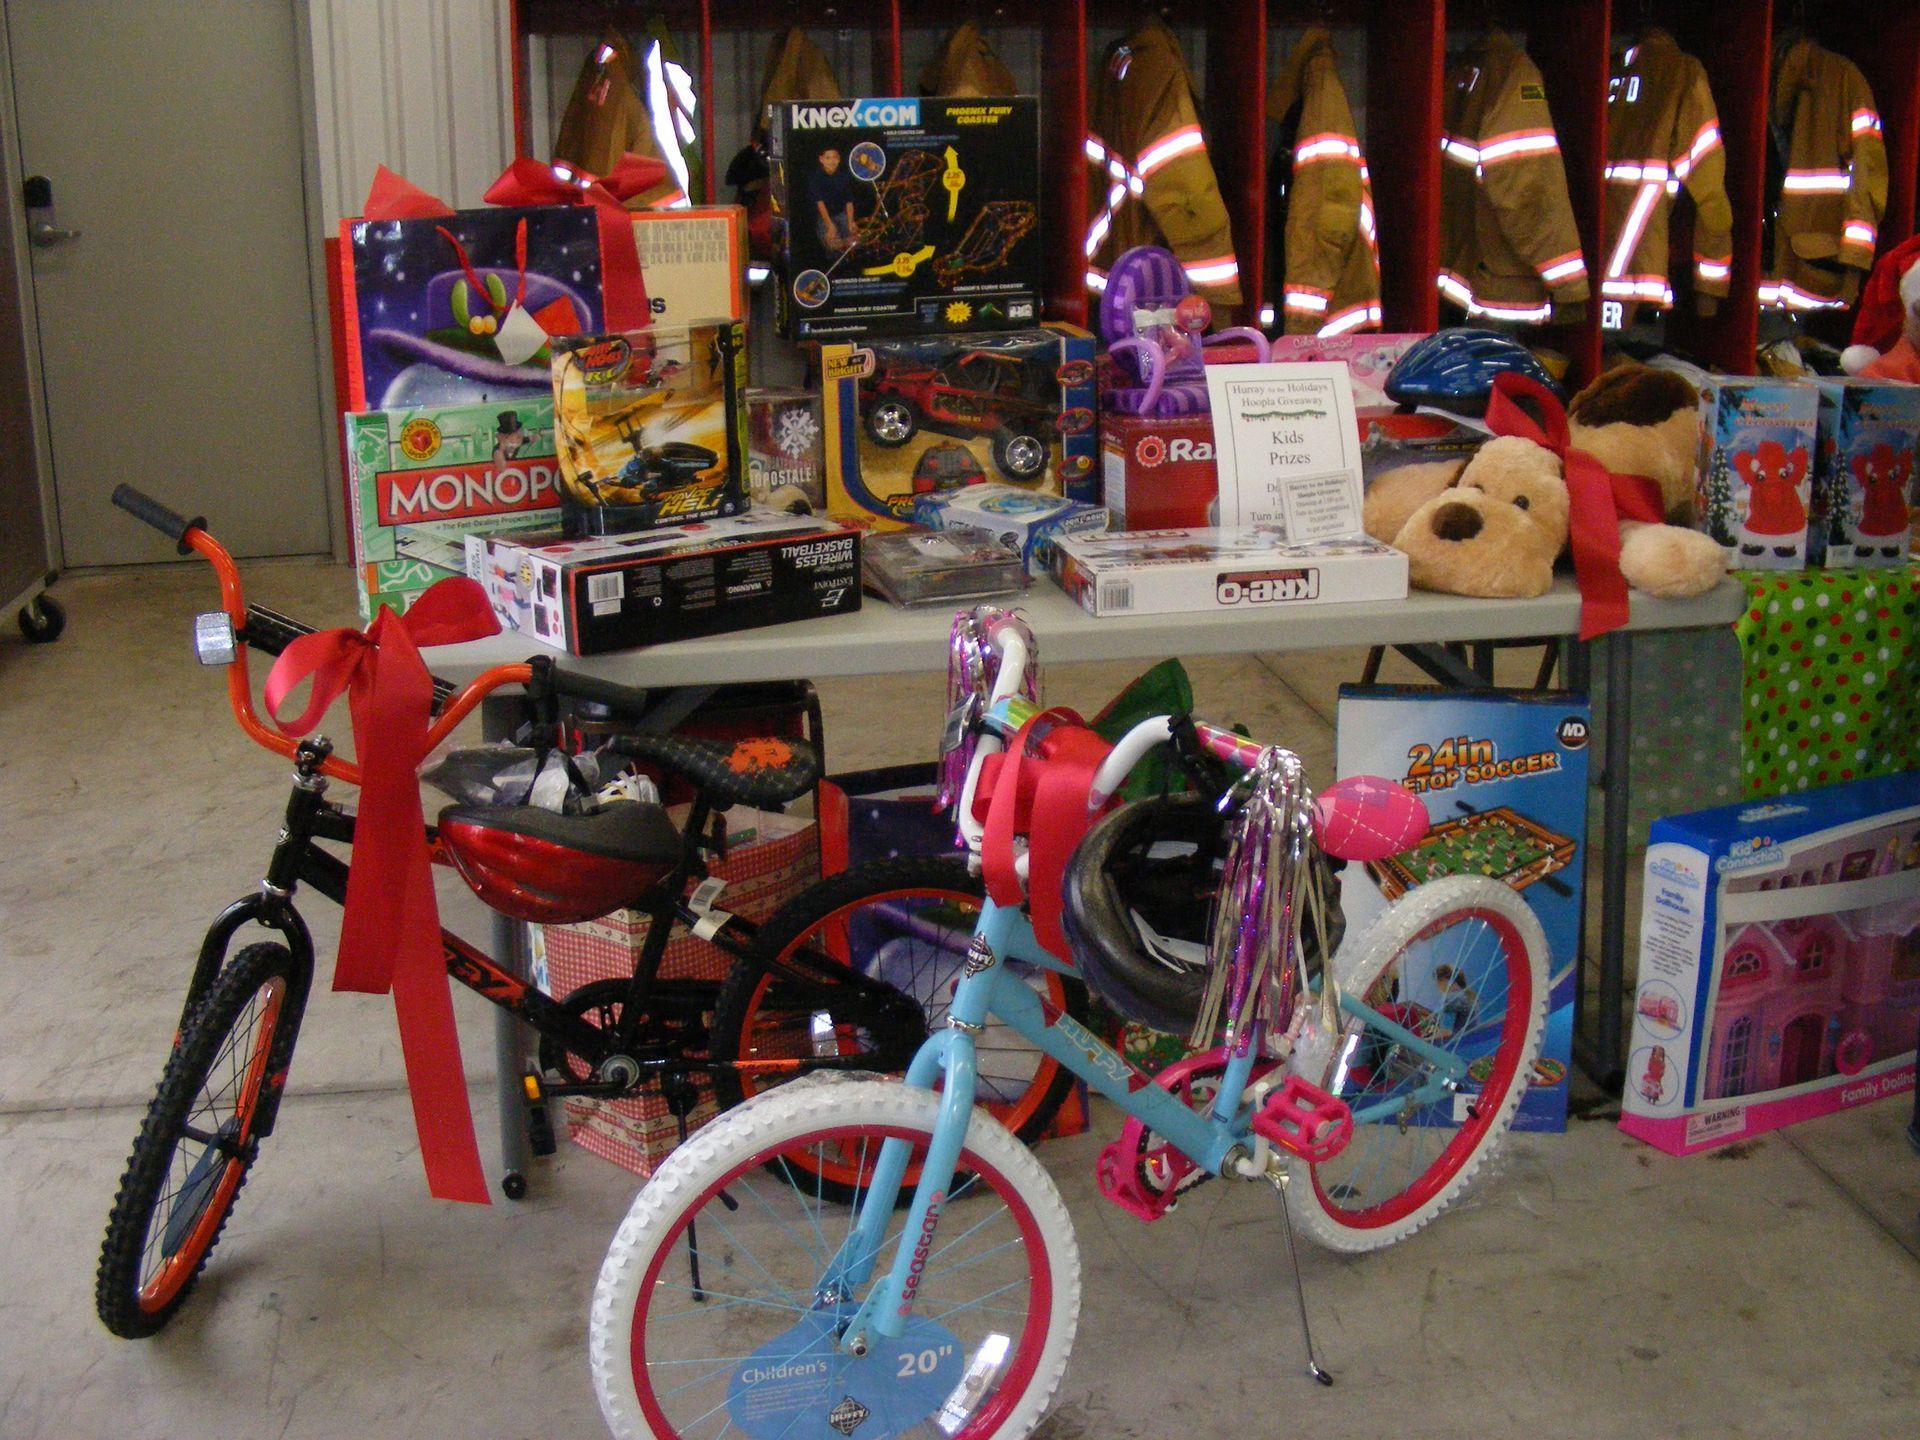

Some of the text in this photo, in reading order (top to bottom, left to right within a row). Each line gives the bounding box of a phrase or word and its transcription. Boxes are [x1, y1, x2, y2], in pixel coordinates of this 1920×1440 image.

[957, 115, 999, 125] COASTER
[1232, 385, 1265, 395] Hurray
[1287, 383, 1329, 393] Holidays
[1241, 396, 1323, 408] Hoopla Giveaway
[1272, 430, 1305, 445] Kids
[1169, 438, 1216, 463] Ra
[1269, 451, 1312, 466] Prizes
[390, 464, 562, 517] MONOP
[782, 538, 853, 559] BASKETBALL
[795, 550, 853, 569] WIRELESS
[1562, 723, 1586, 737] MD
[1407, 736, 1494, 778] 24in
[1464, 752, 1560, 785] SOCCER
[1841, 1081, 1880, 1103] Family
[741, 1360, 828, 1384] Children's
